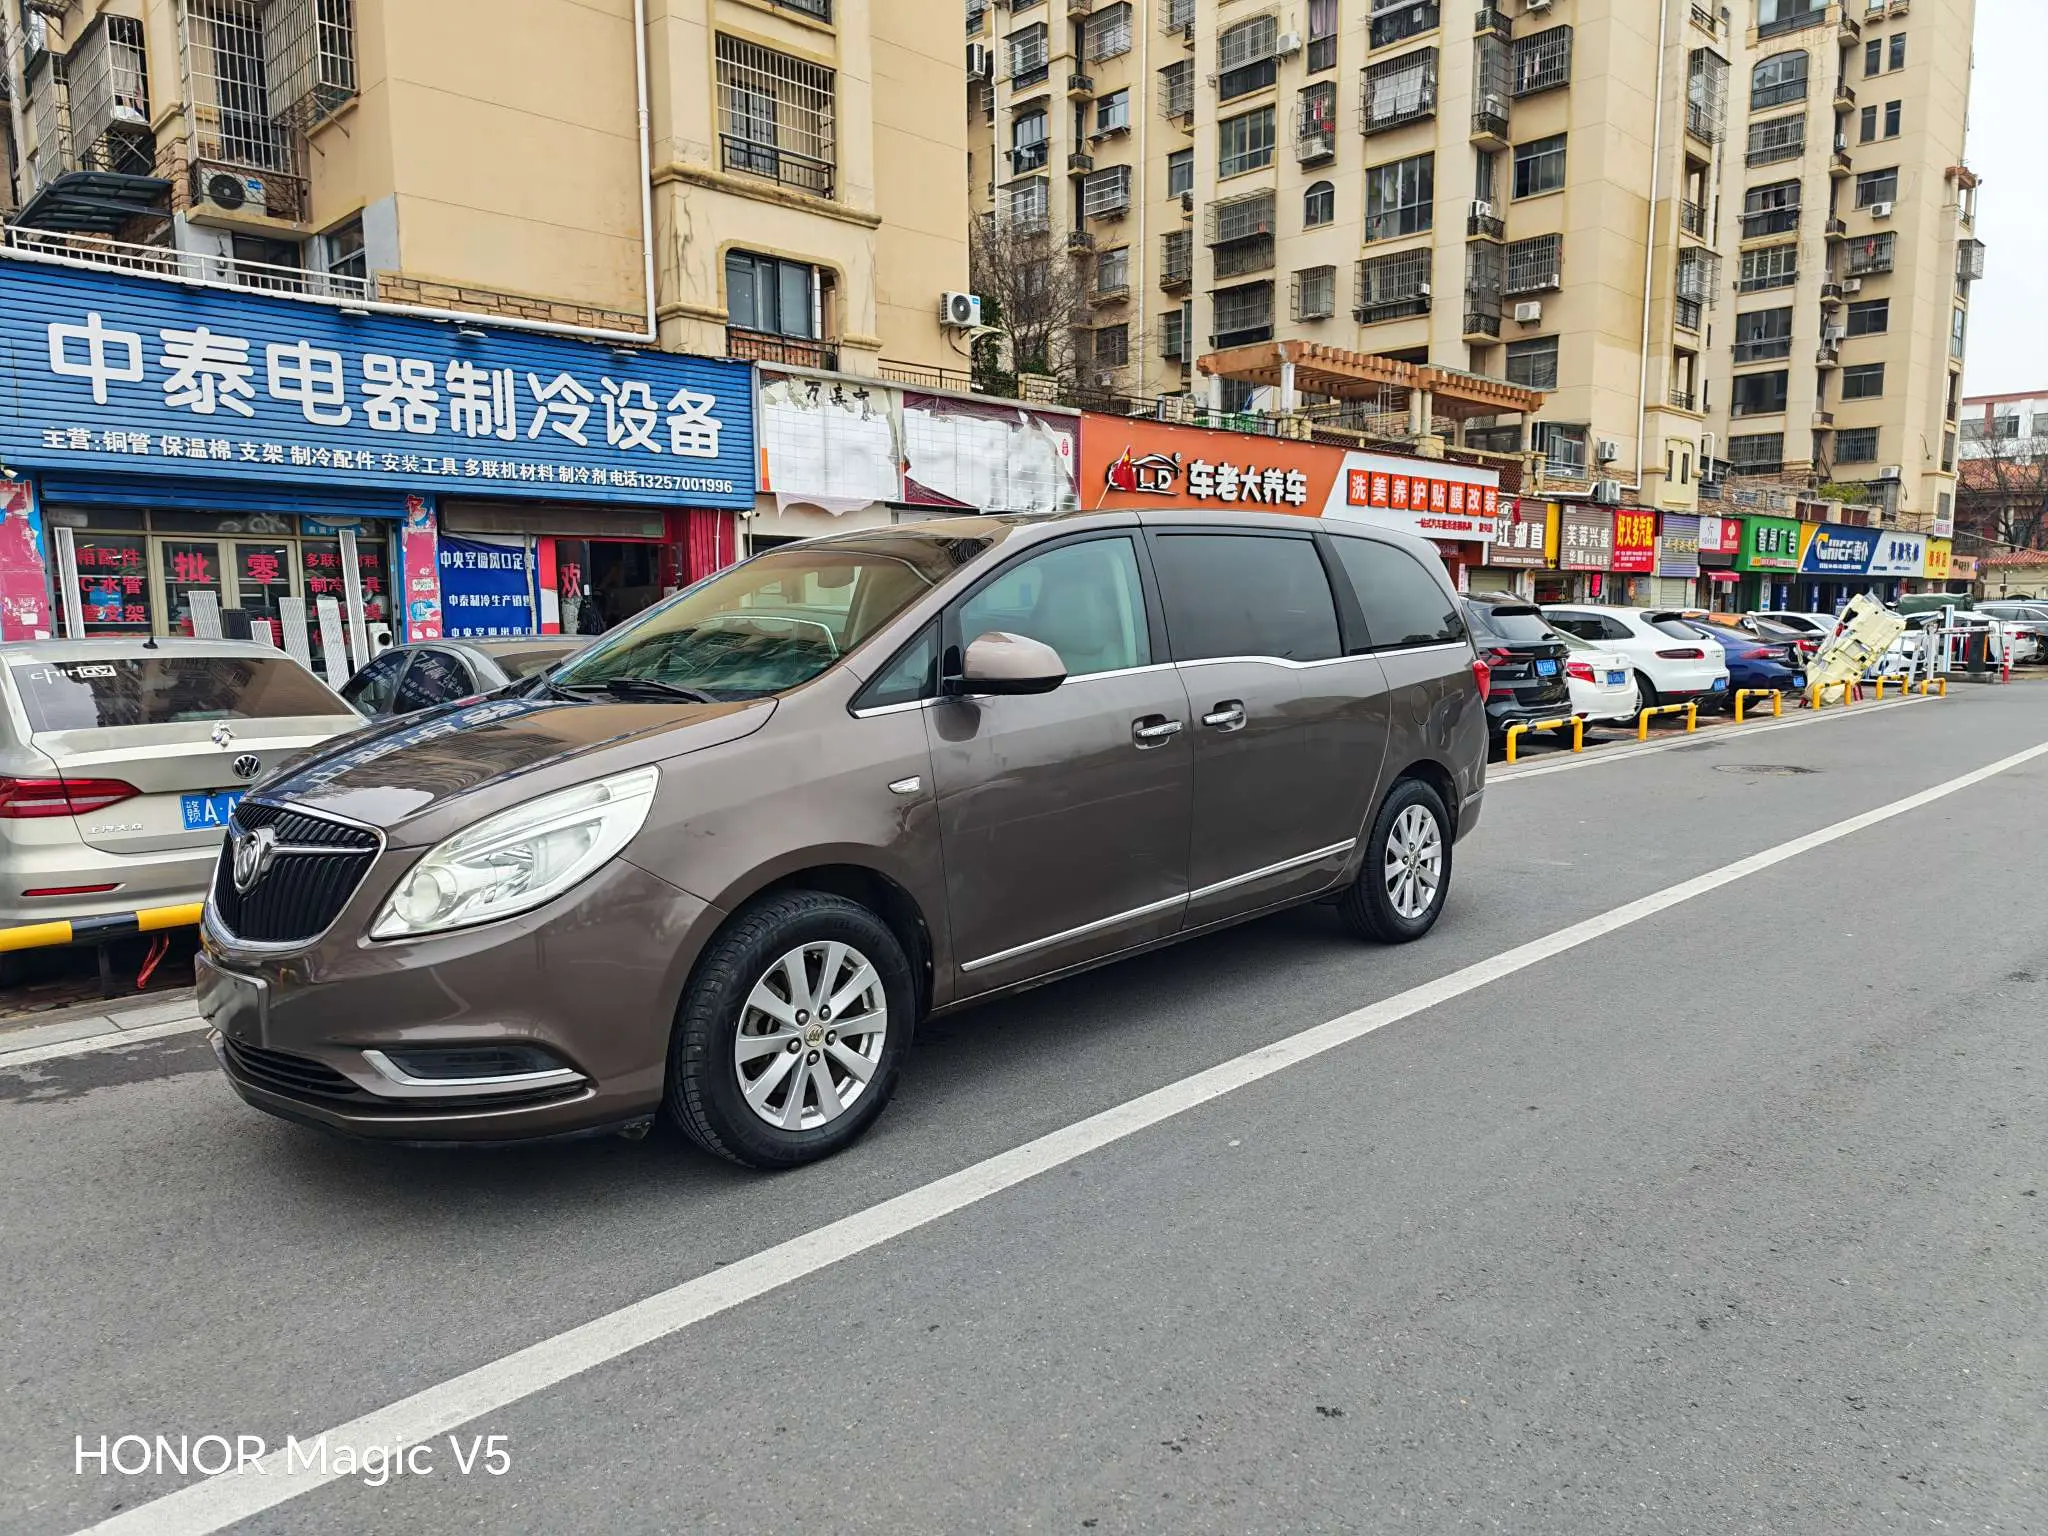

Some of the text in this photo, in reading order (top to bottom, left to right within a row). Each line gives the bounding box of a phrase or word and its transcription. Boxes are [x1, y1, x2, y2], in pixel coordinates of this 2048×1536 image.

[47, 312, 723, 458] 中泰电器制冷设备
[160, 434, 232, 461] 保温棉
[238, 442, 285, 465] 支架
[290, 445, 376, 471] 制冷配件
[381, 453, 458, 476] 安装工具
[464, 459, 554, 483] 多联机材料
[558, 465, 607, 486] 制冷剂
[1187, 458, 1308, 506] 车老大养车
[1351, 473, 1497, 514] 洗美养护贴膜改装
[174, 551, 280, 585] 批 零
